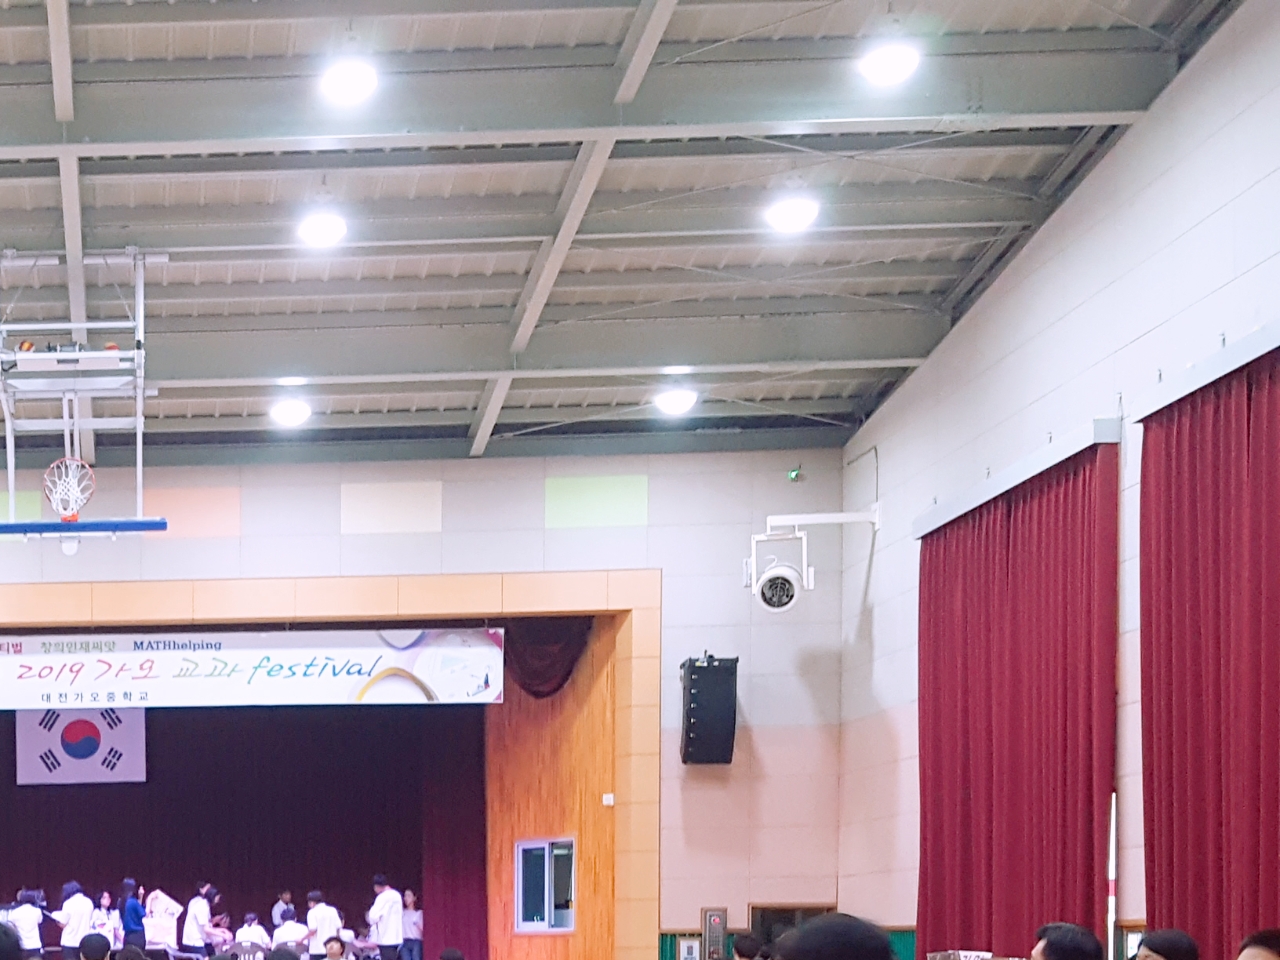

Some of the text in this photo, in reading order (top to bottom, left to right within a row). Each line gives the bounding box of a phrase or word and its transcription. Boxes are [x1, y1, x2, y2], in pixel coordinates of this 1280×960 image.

[40, 640, 116, 655] 창의인재씨앗
[132, 640, 223, 652] MATHhelping
[17, 661, 86, 687] 2019
[94, 657, 161, 681] 가오
[172, 657, 244, 679] 교과
[247, 654, 383, 685] festival
